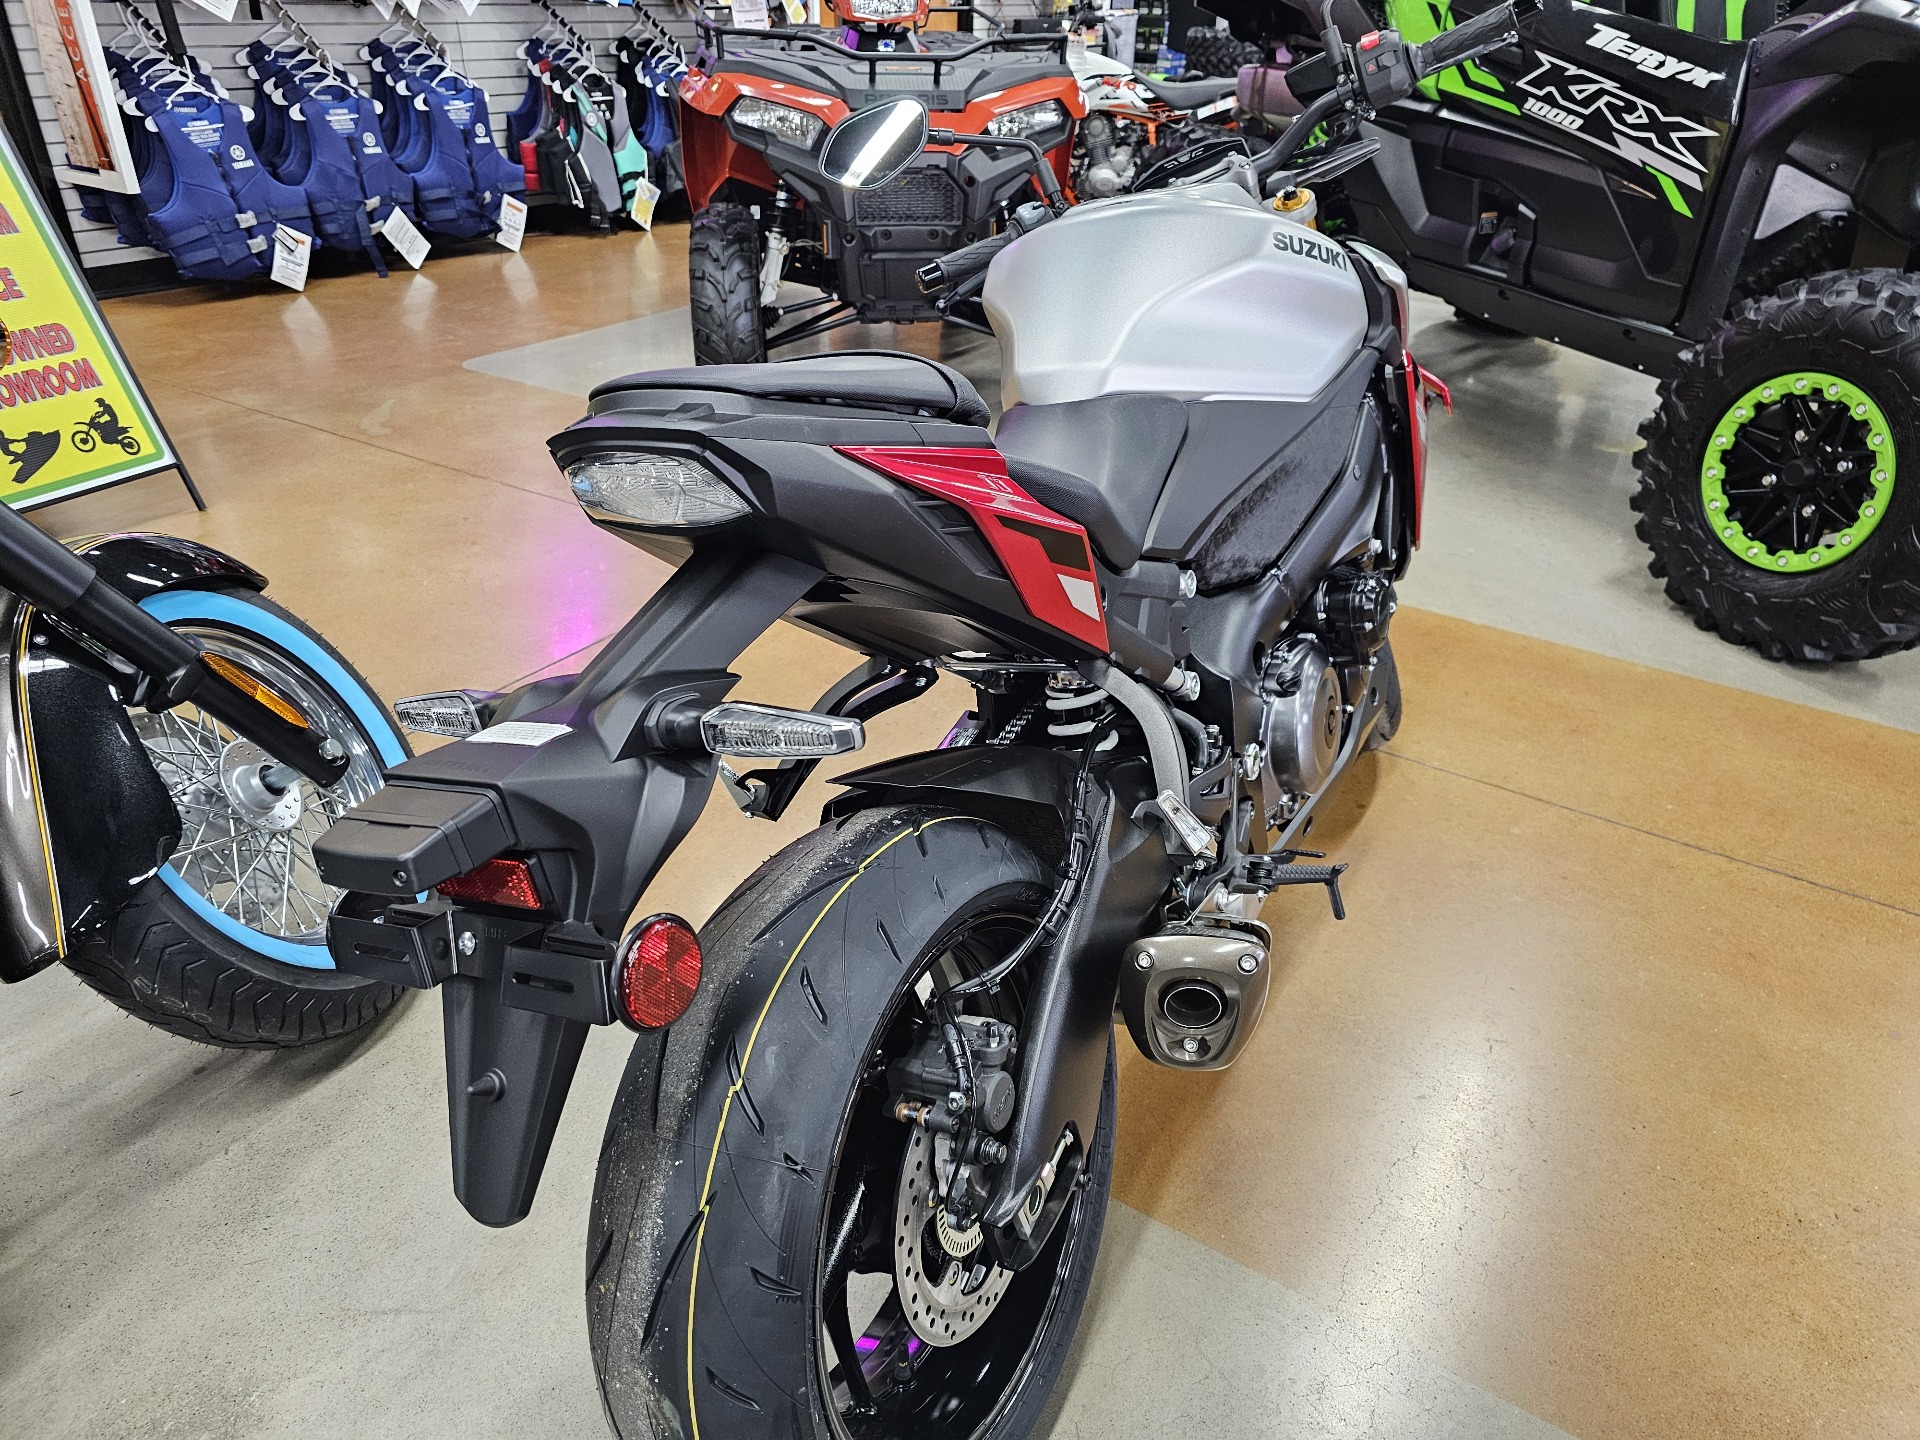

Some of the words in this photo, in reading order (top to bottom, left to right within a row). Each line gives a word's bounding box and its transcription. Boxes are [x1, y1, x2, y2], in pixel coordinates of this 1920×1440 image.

[864, 93, 949, 106] PRIS
[1516, 50, 1720, 172] KRX
[1523, 96, 1584, 130] 1000
[1272, 231, 1348, 272] SUZUKI
[7, 322, 76, 365] WNED
